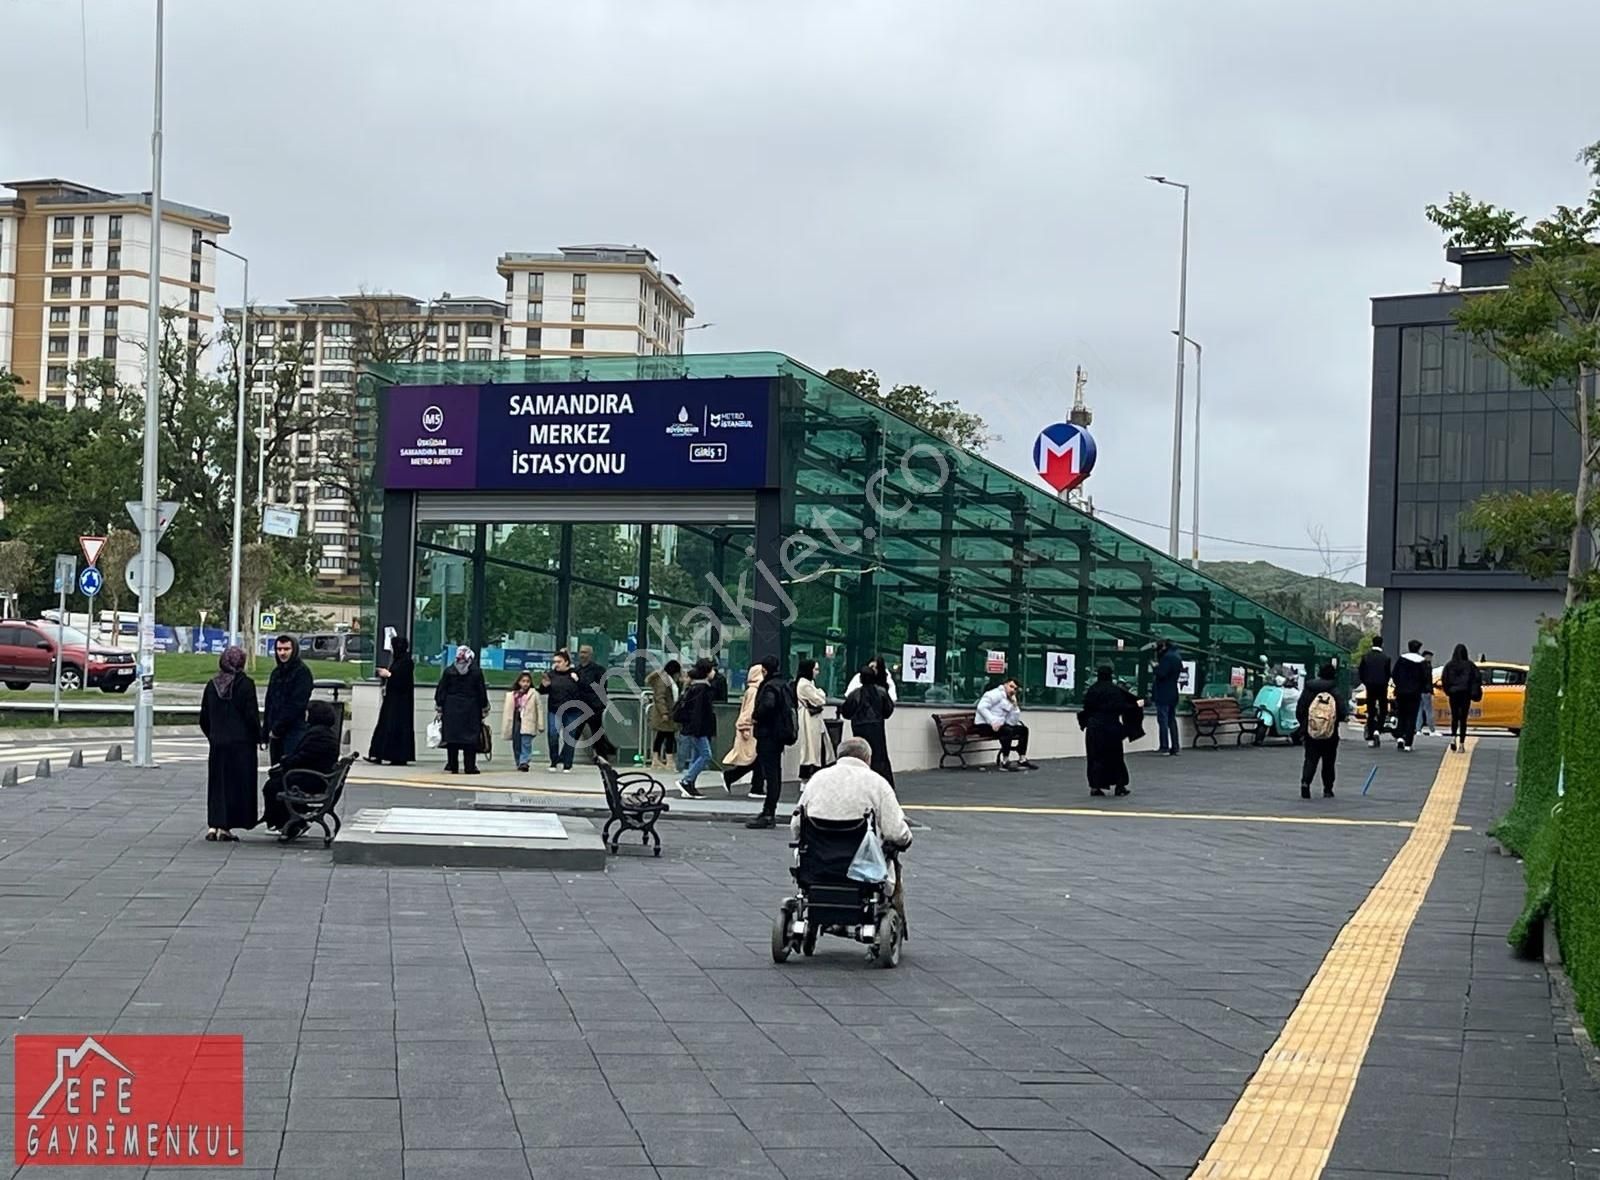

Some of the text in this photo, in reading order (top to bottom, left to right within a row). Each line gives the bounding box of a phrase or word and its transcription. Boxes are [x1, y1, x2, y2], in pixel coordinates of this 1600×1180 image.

[509, 393, 634, 416] SAMANDIRA
[425, 414, 440, 425] M5
[530, 423, 610, 444] MERKEZ
[512, 449, 626, 475] İSTASYONU
[694, 446, 722, 459] GİRİŞ 1
